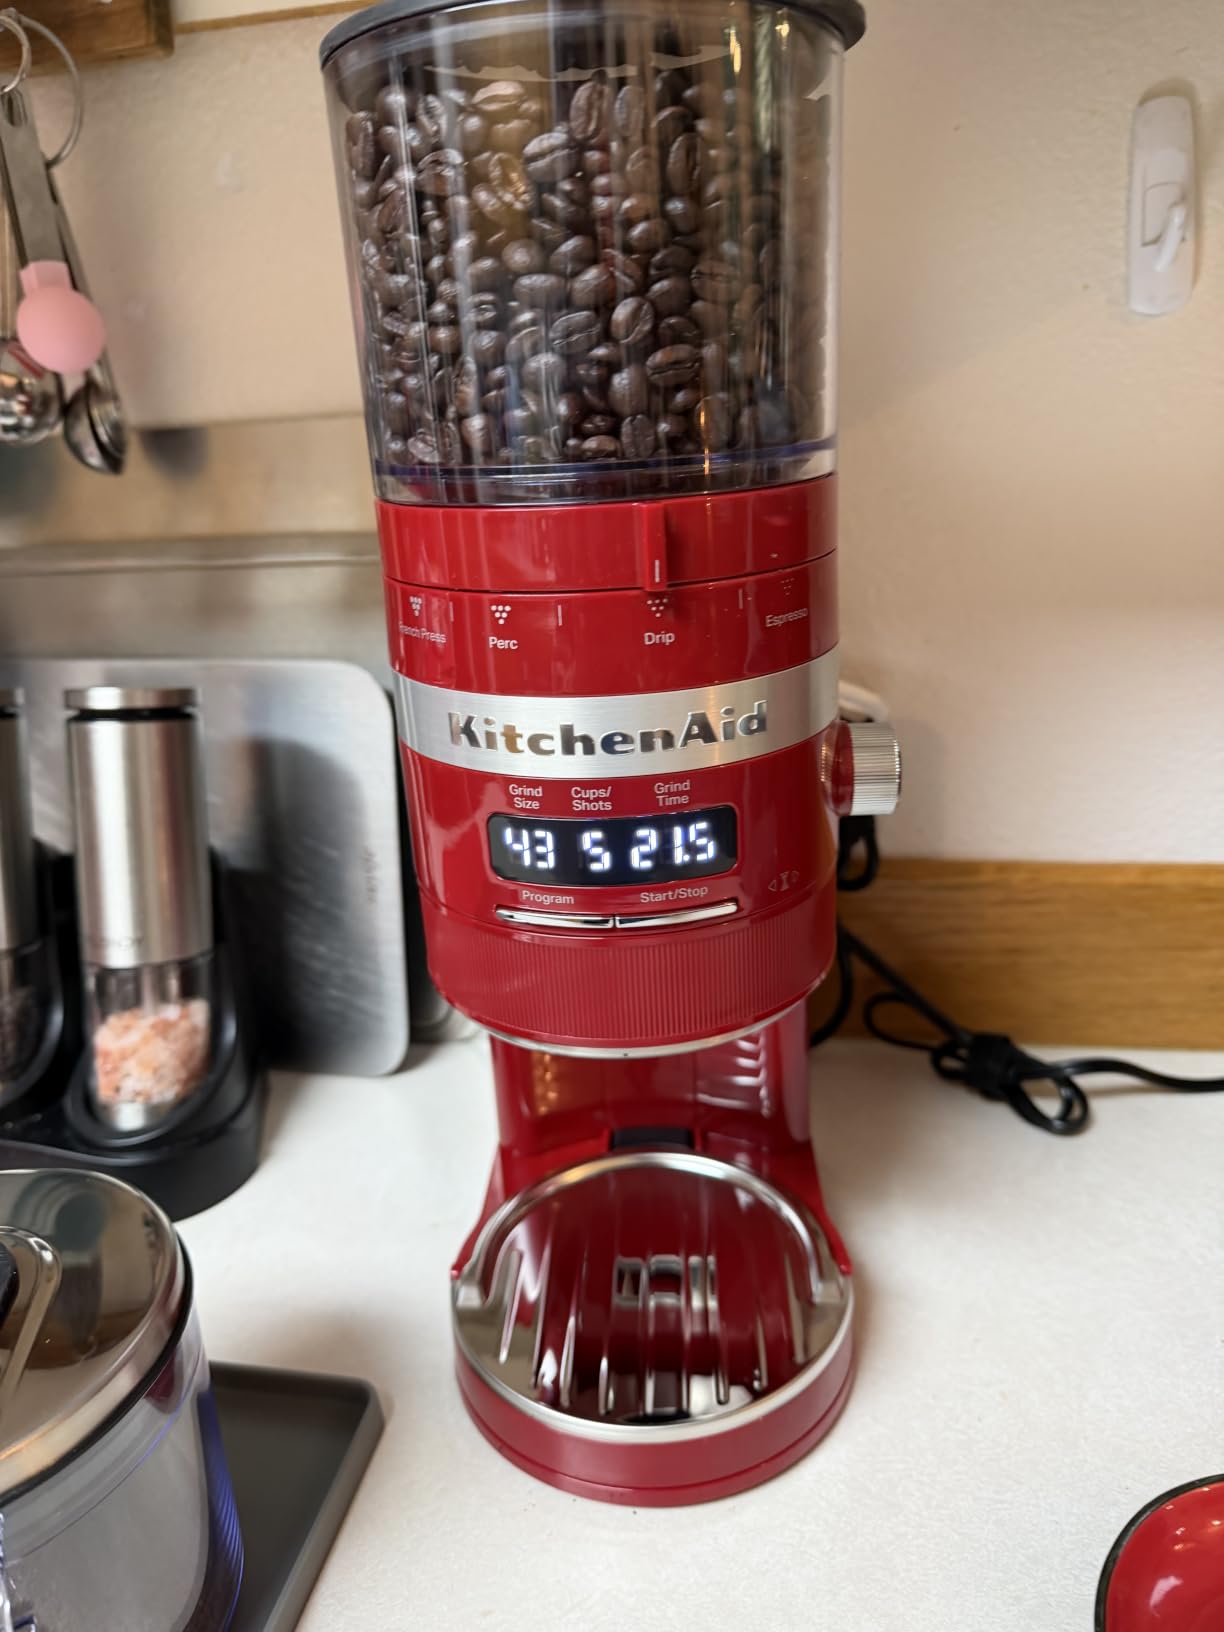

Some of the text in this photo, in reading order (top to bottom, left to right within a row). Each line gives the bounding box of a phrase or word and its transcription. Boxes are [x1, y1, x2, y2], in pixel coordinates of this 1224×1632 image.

[765, 608, 808, 627] Espresso
[421, 628, 446, 643] Press
[488, 636, 518, 650] Perc
[644, 631, 676, 646] Drip
[448, 700, 768, 756] KitchenAid
[508, 784, 543, 798] Grind
[571, 786, 612, 801] Cups/
[654, 780, 691, 794] Grind
[513, 797, 540, 810] Size
[572, 799, 613, 812] Shots
[656, 793, 689, 807] Time
[504, 822, 716, 871] 43 5 21.5
[522, 890, 575, 906] Program
[639, 885, 709, 904] Start/Stop
